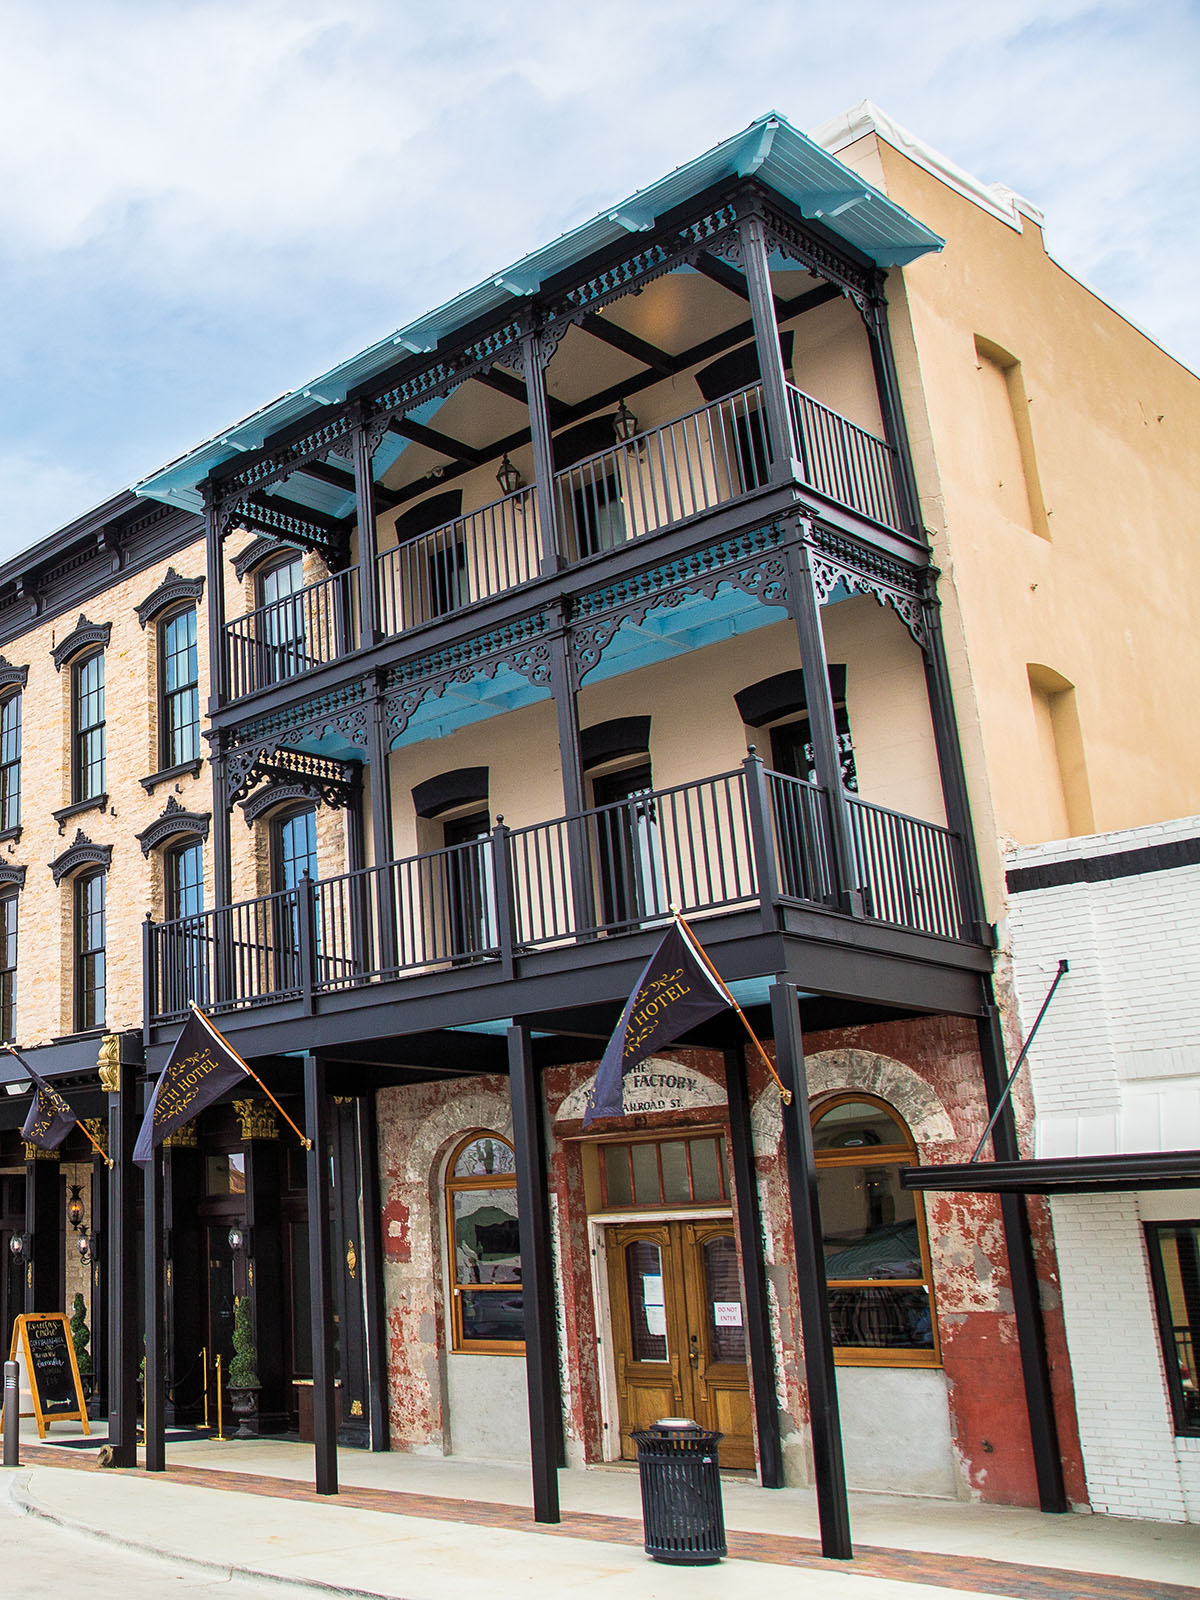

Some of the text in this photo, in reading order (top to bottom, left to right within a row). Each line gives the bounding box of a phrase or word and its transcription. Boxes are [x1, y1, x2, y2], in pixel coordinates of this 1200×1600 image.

[634, 982, 691, 1026] HOTEL
[153, 1059, 219, 1120] MITH HOTEL
[634, 1074, 697, 1091] FACTORY
[623, 1100, 665, 1112] AILROAD
